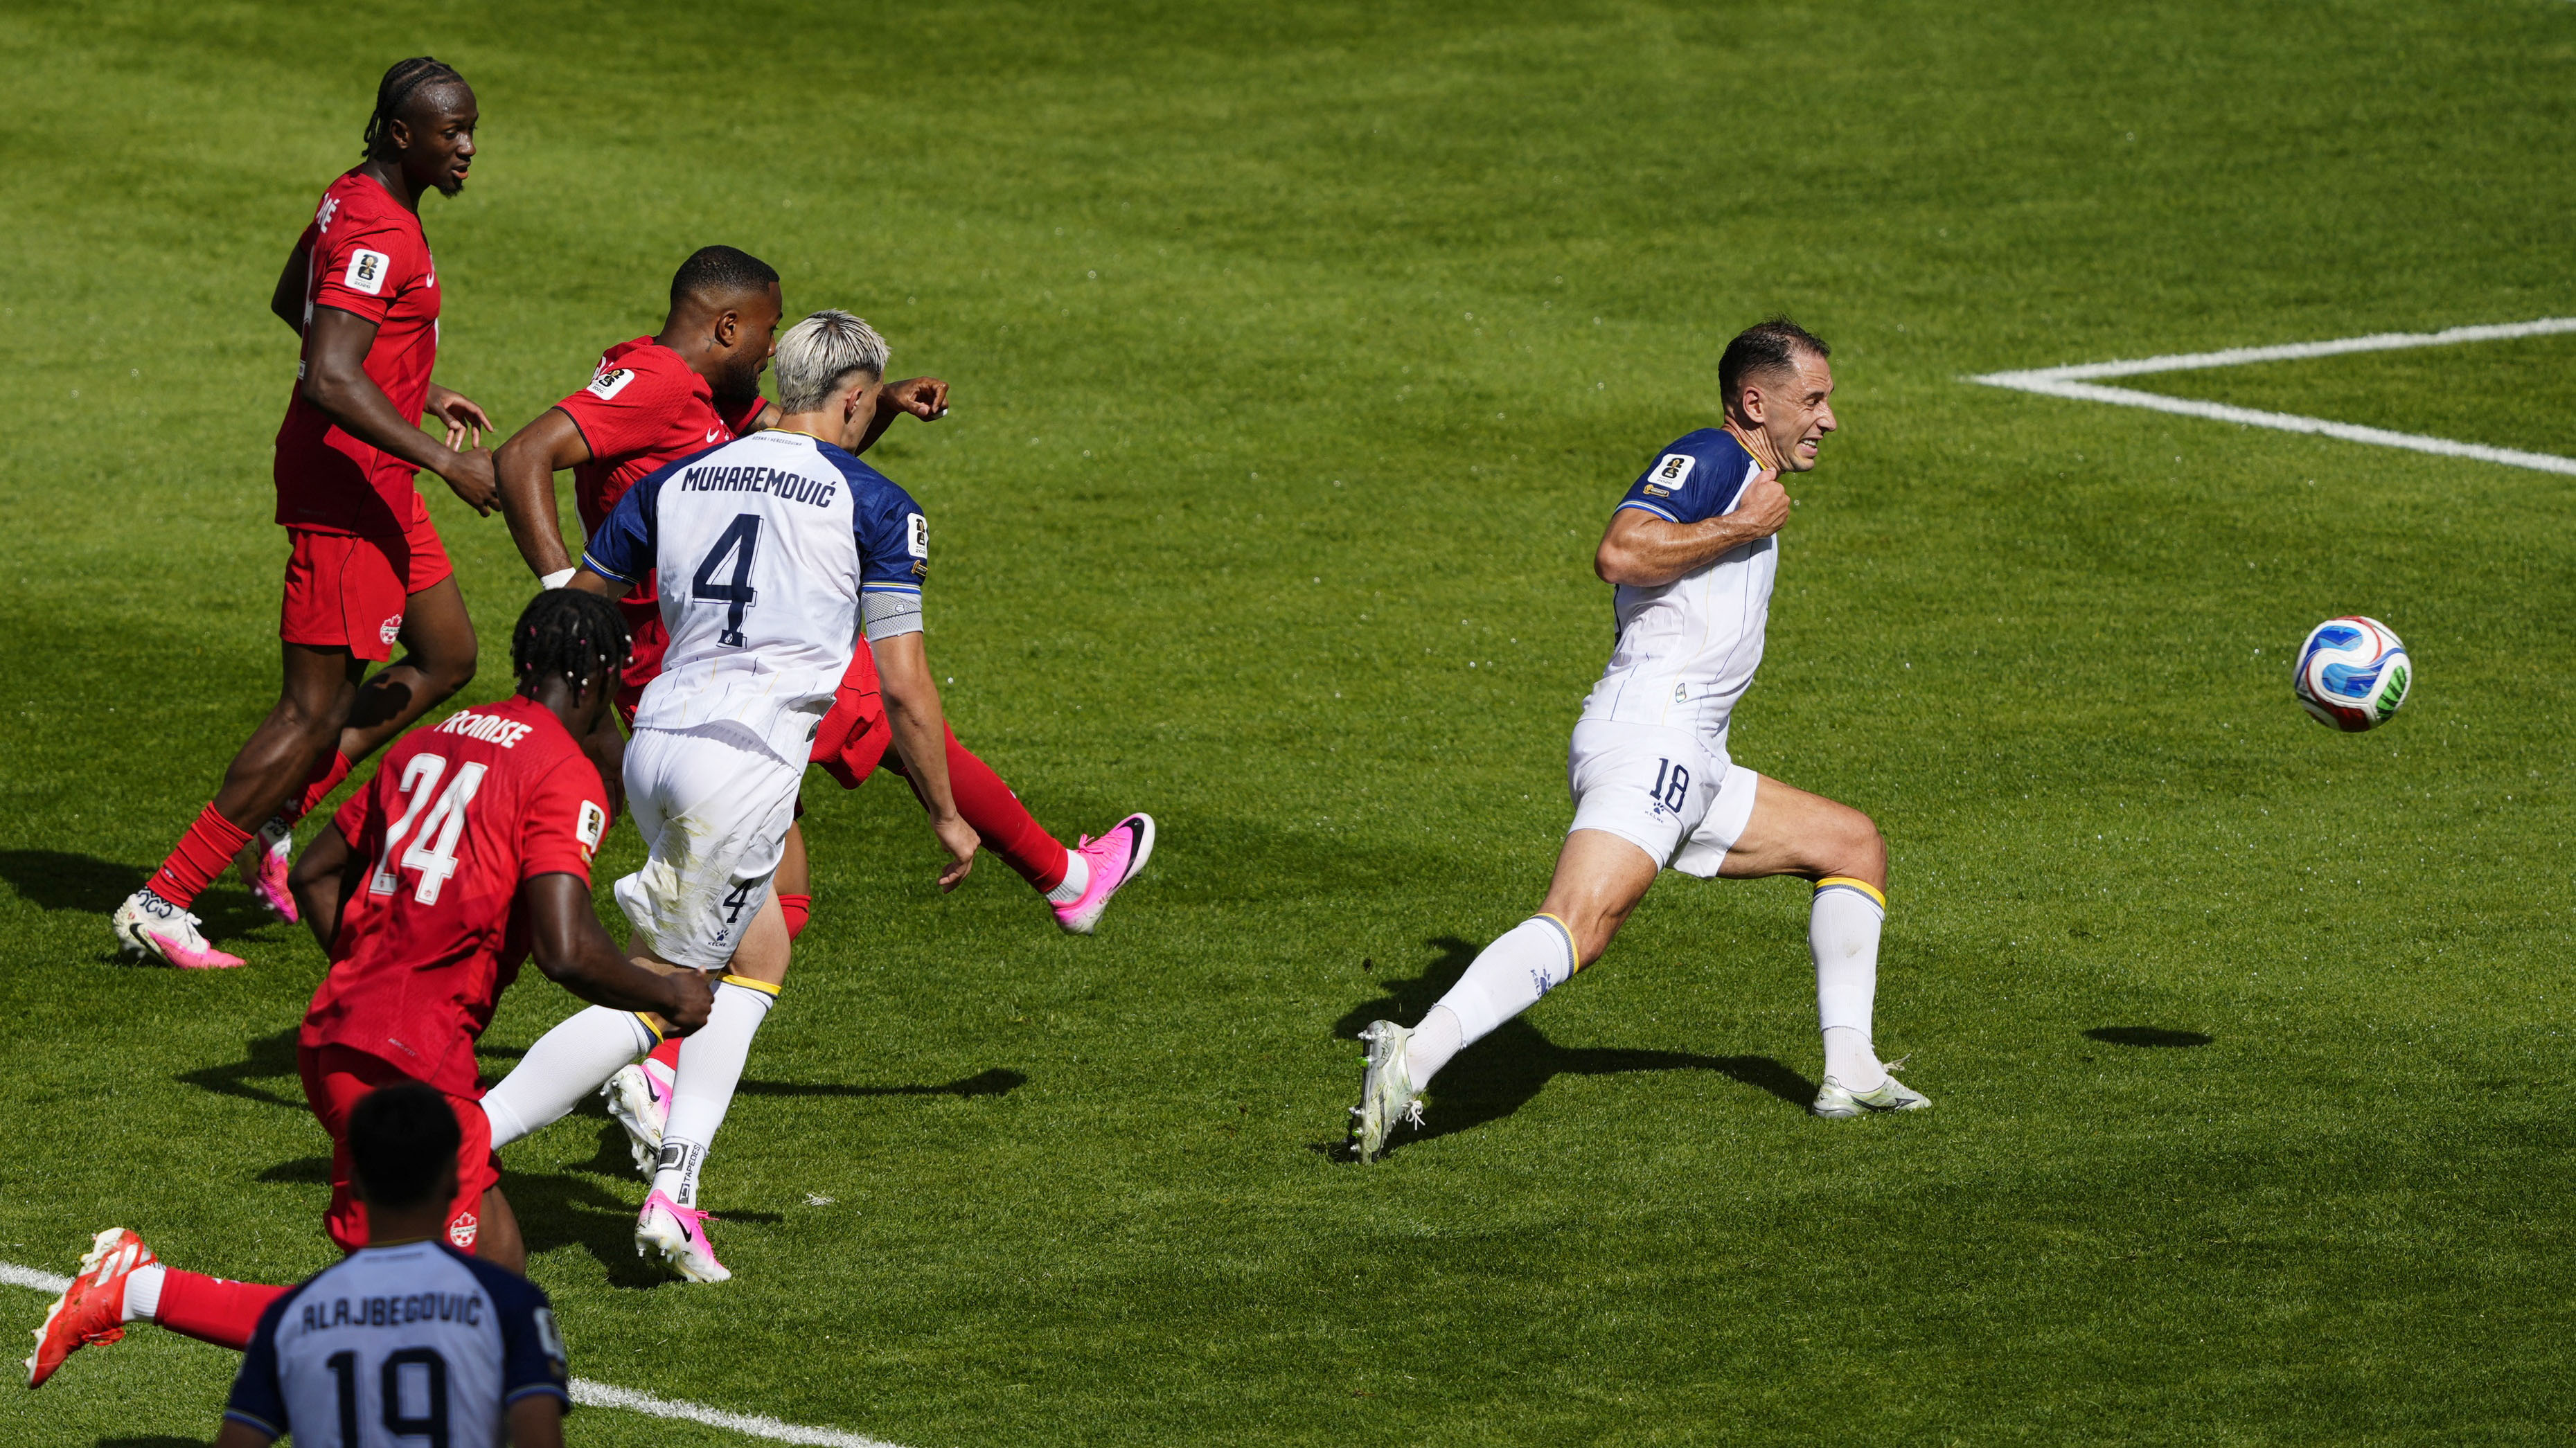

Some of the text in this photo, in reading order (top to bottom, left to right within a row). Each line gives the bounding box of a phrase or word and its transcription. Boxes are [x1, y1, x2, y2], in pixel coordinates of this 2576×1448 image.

[682, 466, 837, 508] MUHAREMOVIĆ
[692, 513, 764, 649] 4
[433, 709, 533, 749] PROMISE
[1649, 758, 1689, 814] 18
[368, 752, 489, 906] 24
[1644, 810, 1664, 824] KELME
[722, 878, 755, 924] 4
[1530, 969, 1540, 998] KEL
[301, 1289, 483, 1335] ALAJBEGOVIĆ
[326, 1345, 452, 1448] 19
